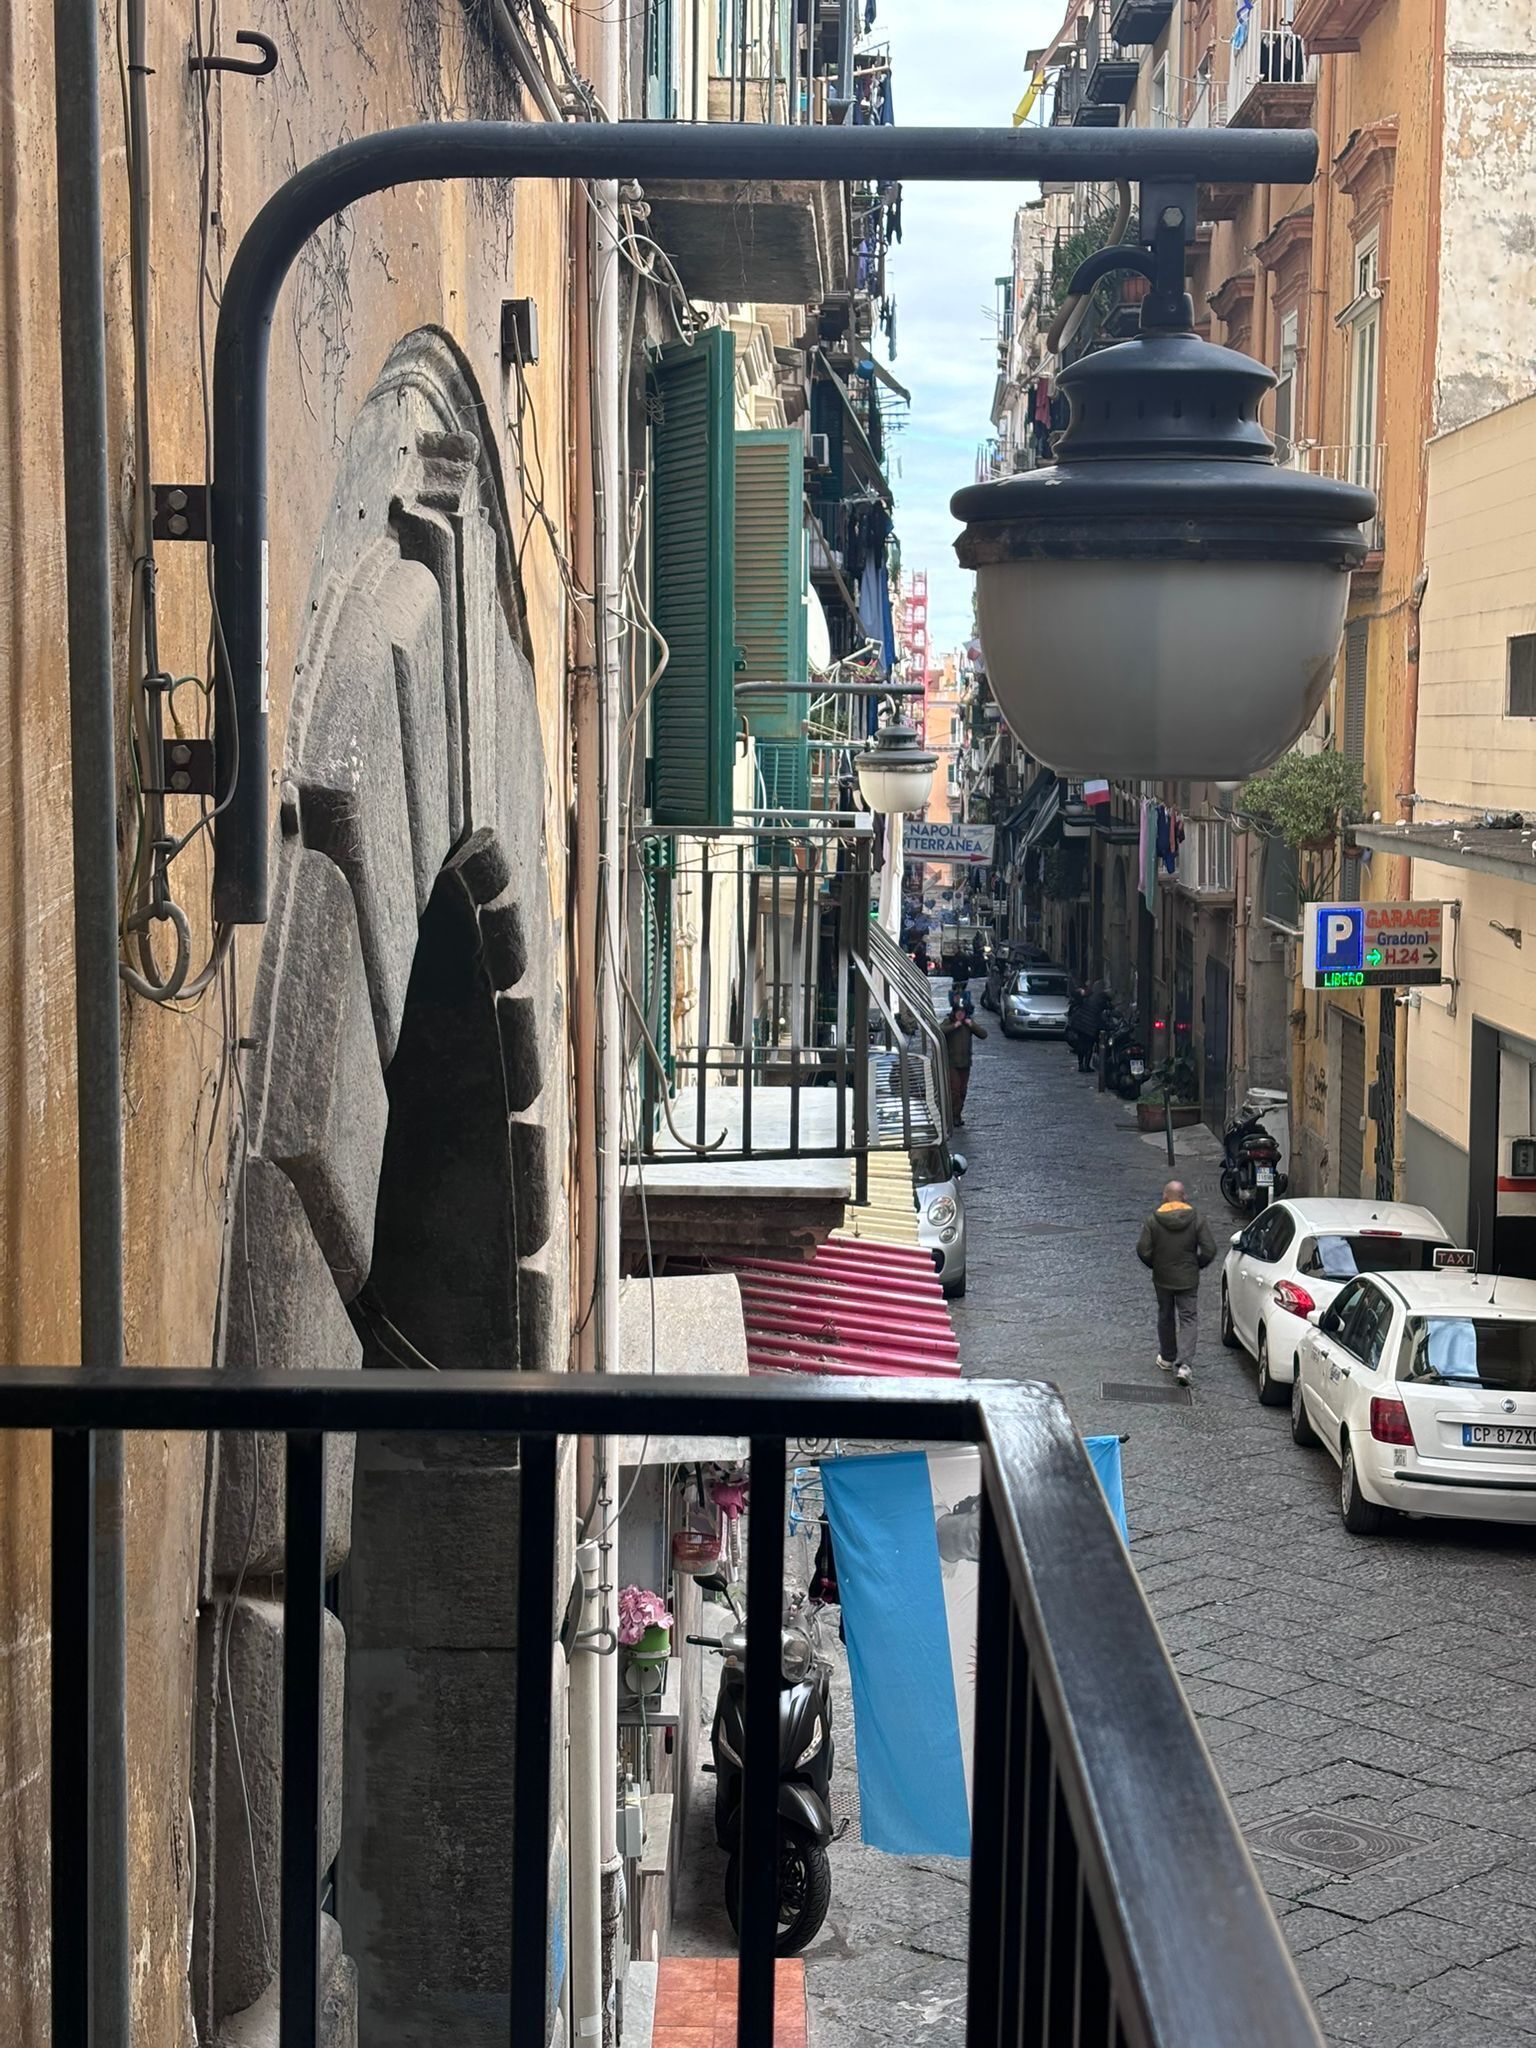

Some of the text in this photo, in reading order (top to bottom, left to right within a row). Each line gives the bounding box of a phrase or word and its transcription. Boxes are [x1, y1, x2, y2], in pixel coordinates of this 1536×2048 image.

[910, 825, 960, 837] NAPOLI
[1365, 908, 1440, 929] GARAGE
[1327, 915, 1353, 954] P
[1377, 931, 1428, 946] Gradoni
[1385, 948, 1420, 965] H.24
[1324, 972, 1364, 987] LIBERO
[1437, 1252, 1471, 1265] TAXI
[1473, 1427, 1491, 1442] CP
[1497, 1428, 1536, 1445] 872X
